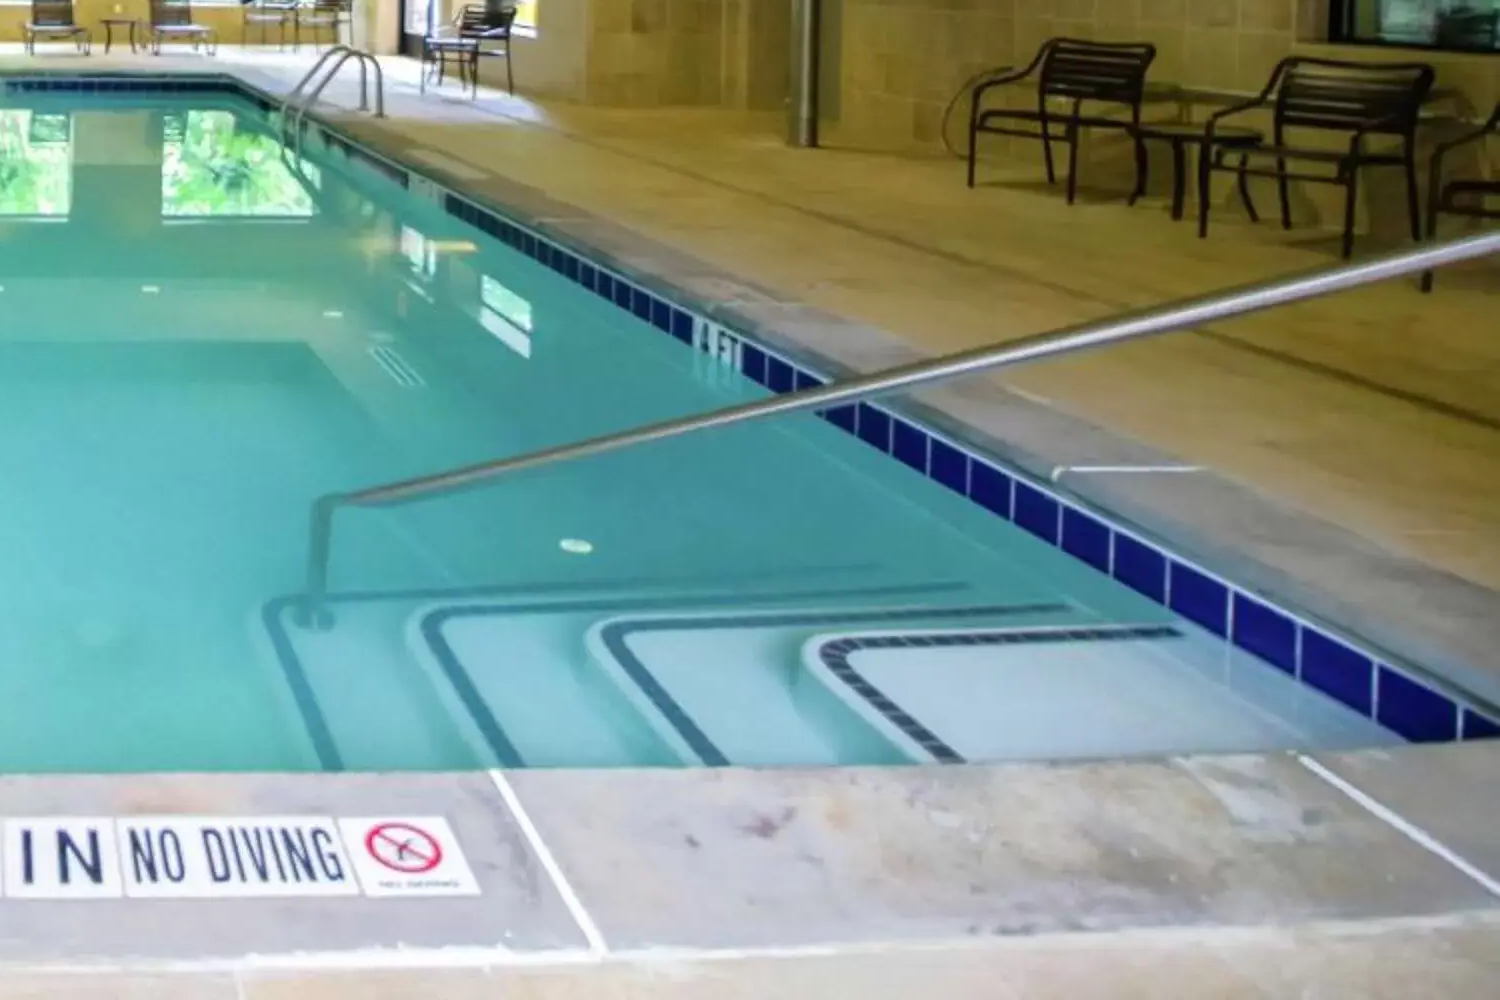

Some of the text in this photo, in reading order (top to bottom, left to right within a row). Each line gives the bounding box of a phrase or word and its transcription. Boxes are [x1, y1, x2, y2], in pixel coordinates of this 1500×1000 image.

[20, 828, 104, 885] IN
[127, 827, 186, 884] NO
[201, 826, 345, 883] DIVING
